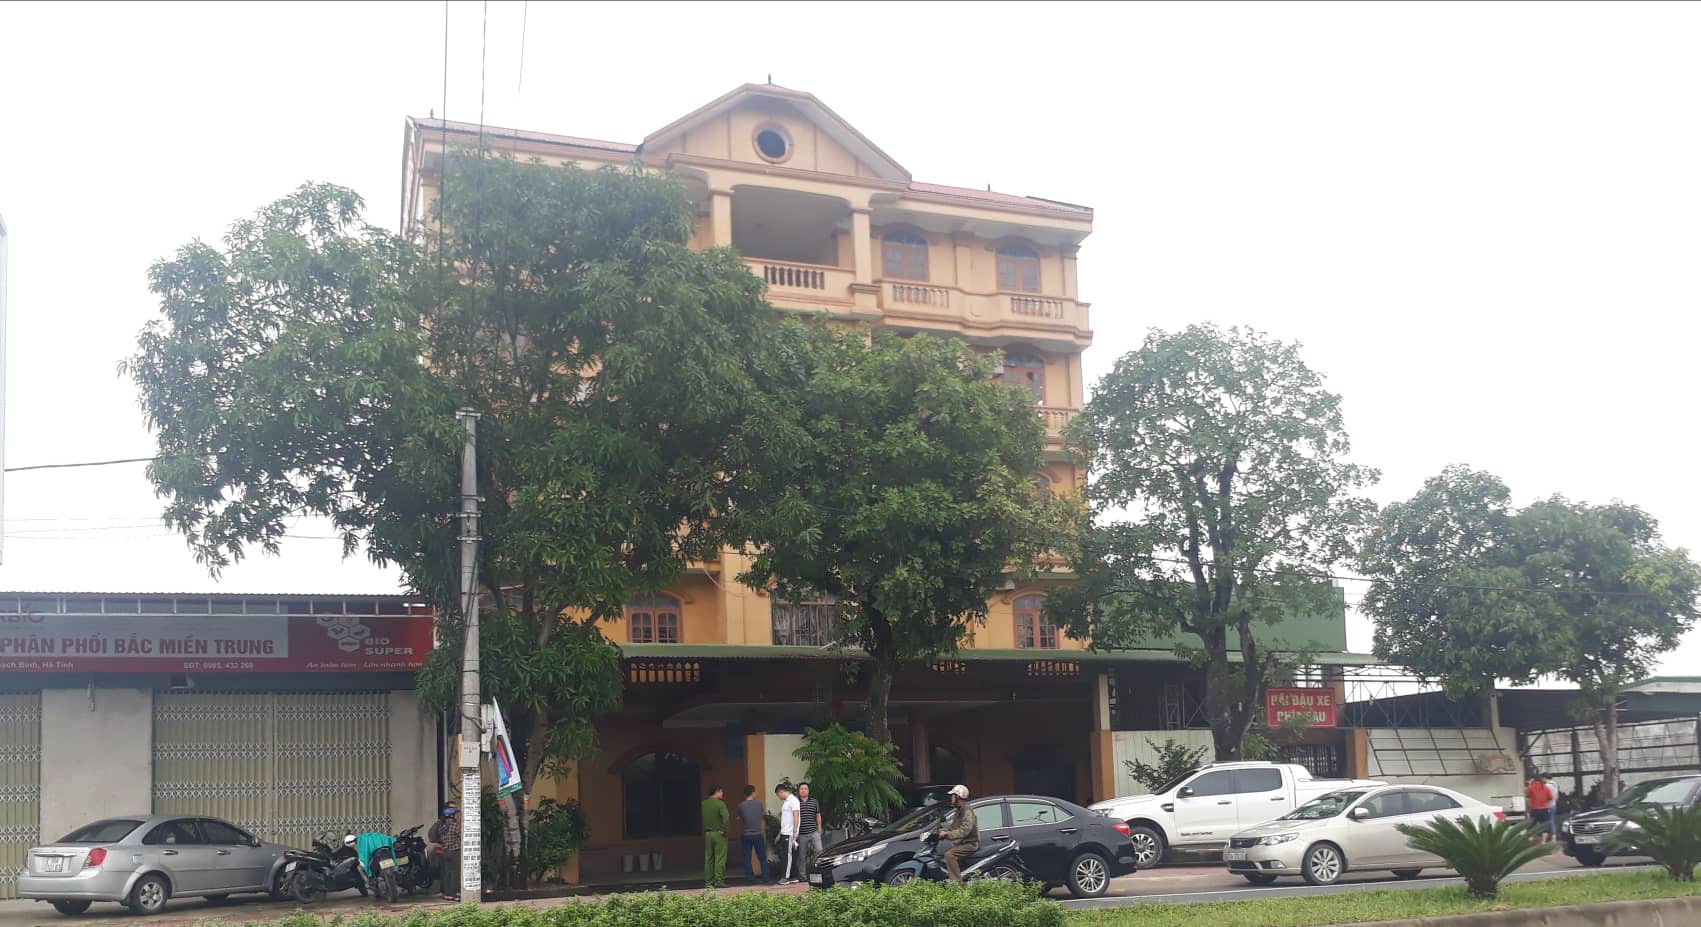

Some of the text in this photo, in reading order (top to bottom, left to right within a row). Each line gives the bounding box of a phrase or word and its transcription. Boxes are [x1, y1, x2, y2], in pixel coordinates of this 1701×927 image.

[0, 633, 55, 653] PHÂN
[62, 632, 108, 654] PHỐI
[114, 633, 153, 654] BẮC
[214, 639, 274, 654] TRUNG
[365, 647, 413, 656] SUPER
[1317, 695, 1331, 706] XE
